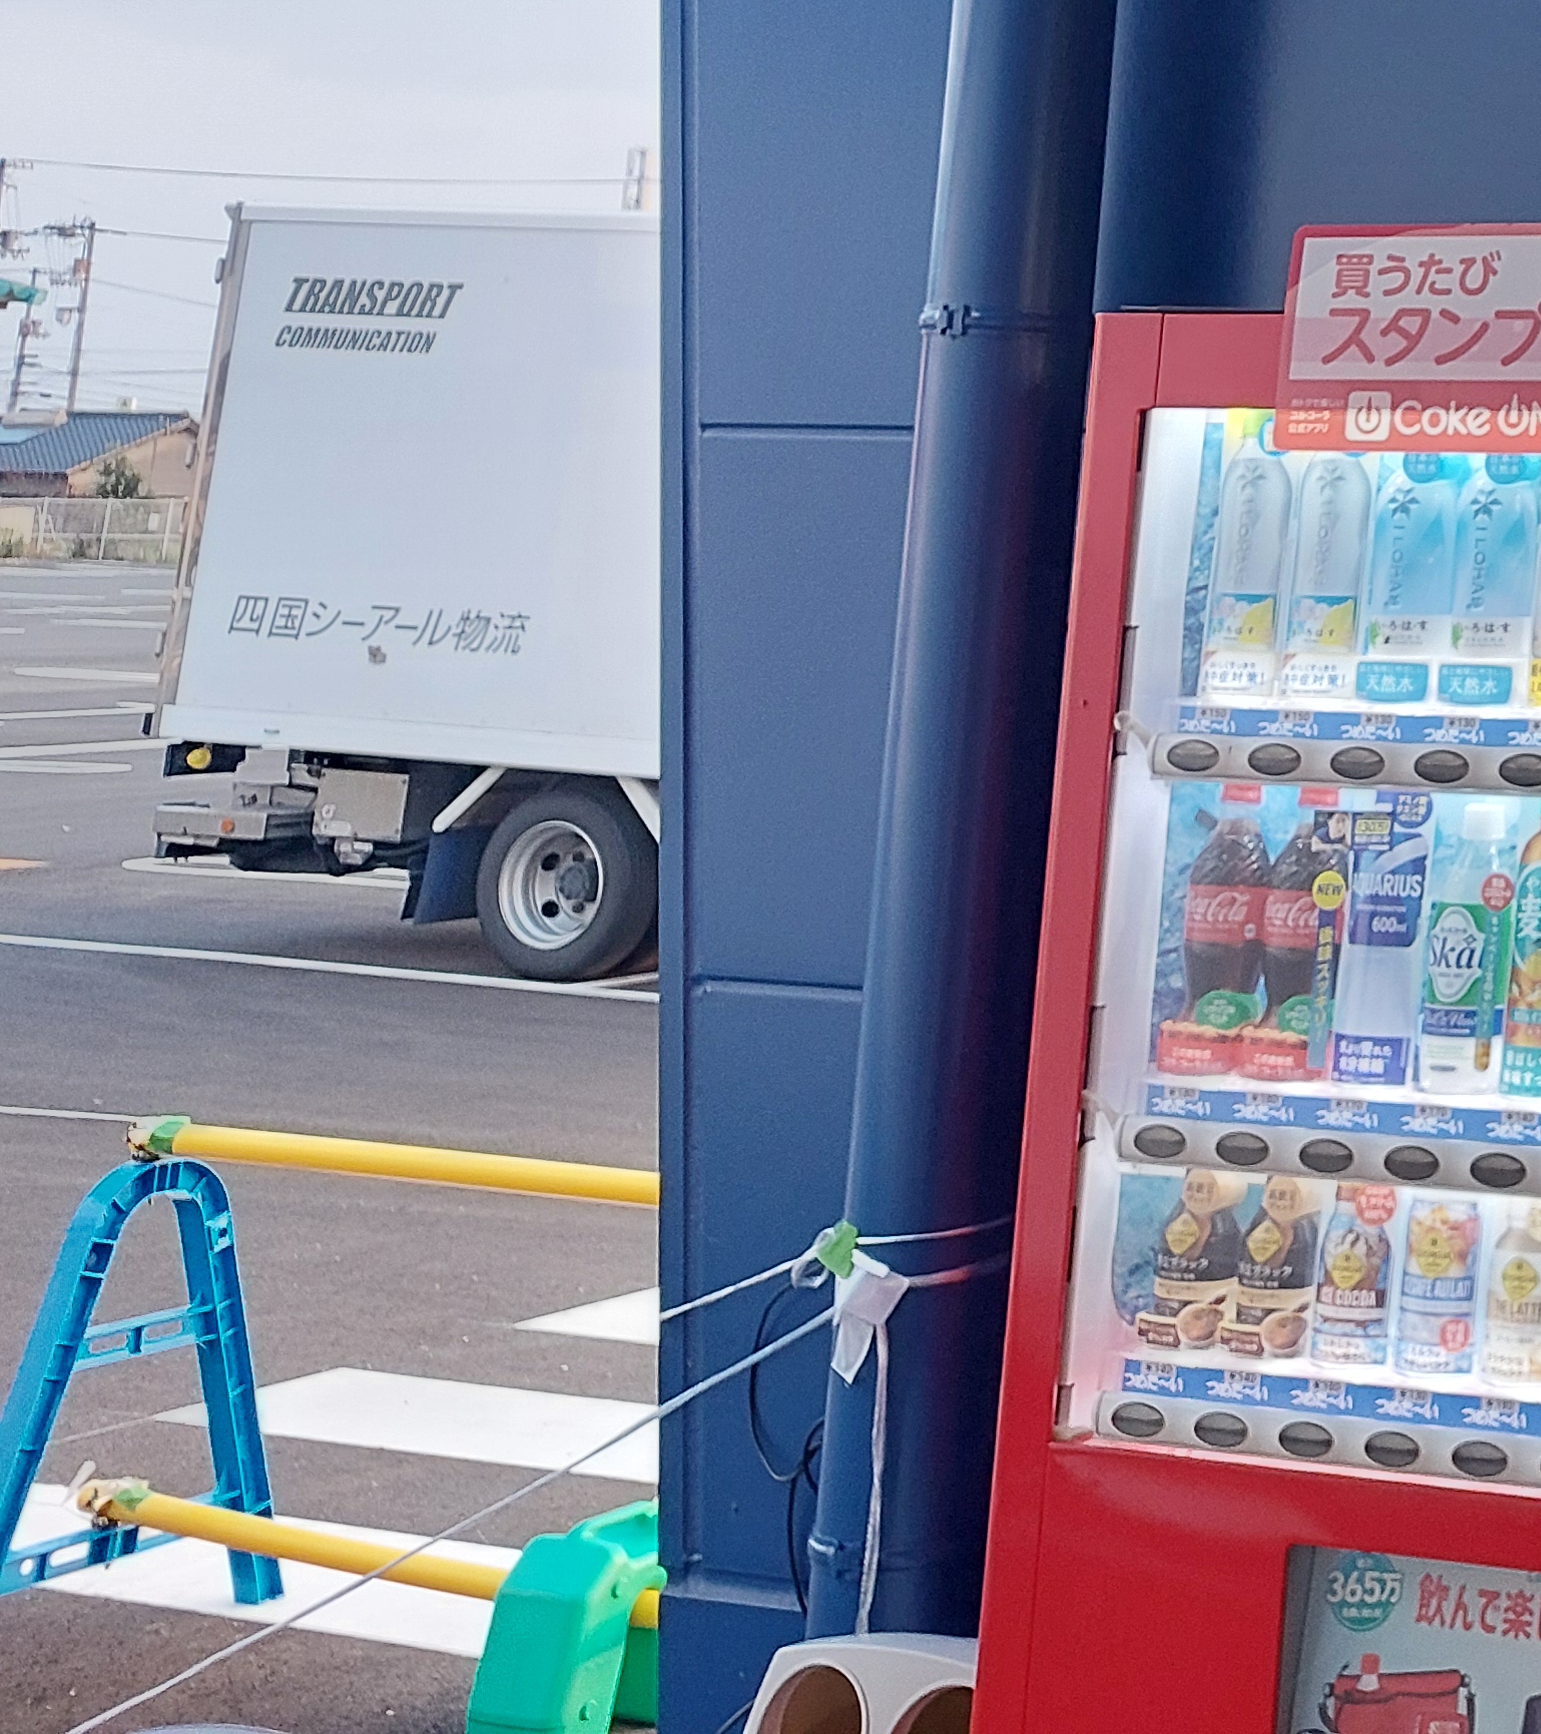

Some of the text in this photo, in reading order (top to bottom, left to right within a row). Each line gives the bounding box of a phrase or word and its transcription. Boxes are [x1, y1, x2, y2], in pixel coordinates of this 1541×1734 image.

[1331, 250, 1502, 299] 買うたび
[284, 277, 464, 319] TRANSPORT
[275, 325, 436, 354] COMMUNICATION
[1394, 400, 1491, 437] Coke
[228, 594, 531, 656] 四国シーアール物流
[1364, 674, 1414, 693] 天然水
[1447, 676, 1498, 695] 天然水
[1316, 883, 1345, 898] NEW
[1326, 1570, 1402, 1606] 365万
